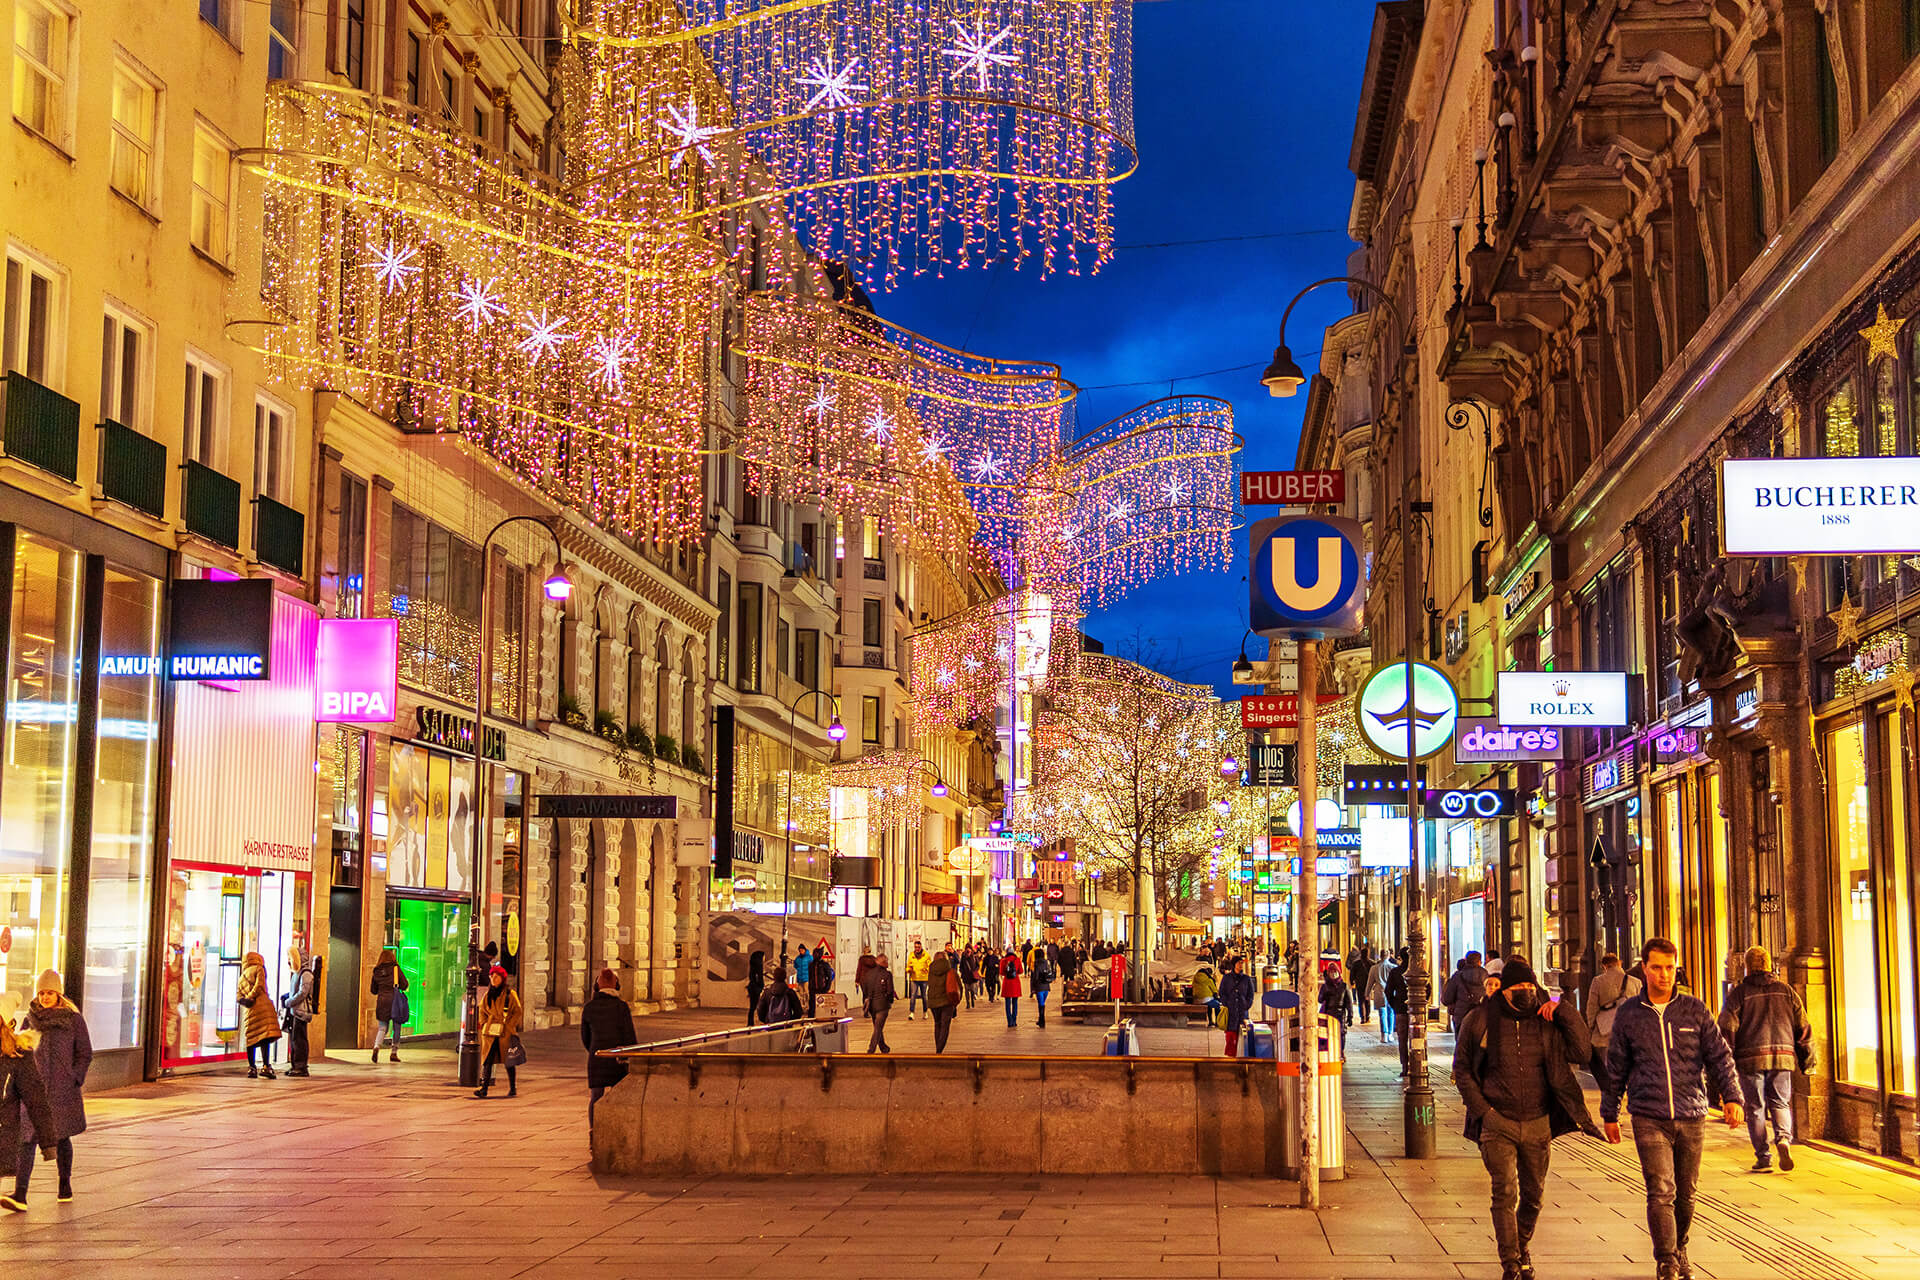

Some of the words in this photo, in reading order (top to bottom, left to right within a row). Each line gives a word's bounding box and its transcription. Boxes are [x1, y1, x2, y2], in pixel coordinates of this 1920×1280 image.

[1246, 474, 1335, 499] HUBER
[1755, 485, 1919, 508] BUCHERER
[1821, 514, 1851, 525] 1888
[1271, 537, 1342, 612] U
[172, 656, 264, 676] HUMANIC
[322, 691, 387, 715] BIPA
[1530, 702, 1595, 715] ROLEX
[416, 706, 507, 761] SALAMADER
[1461, 725, 1559, 752] claire's
[1258, 747, 1285, 768] LOOS
[985, 840, 1014, 849] KLIMT
[1315, 834, 1361, 845] WAROVS
